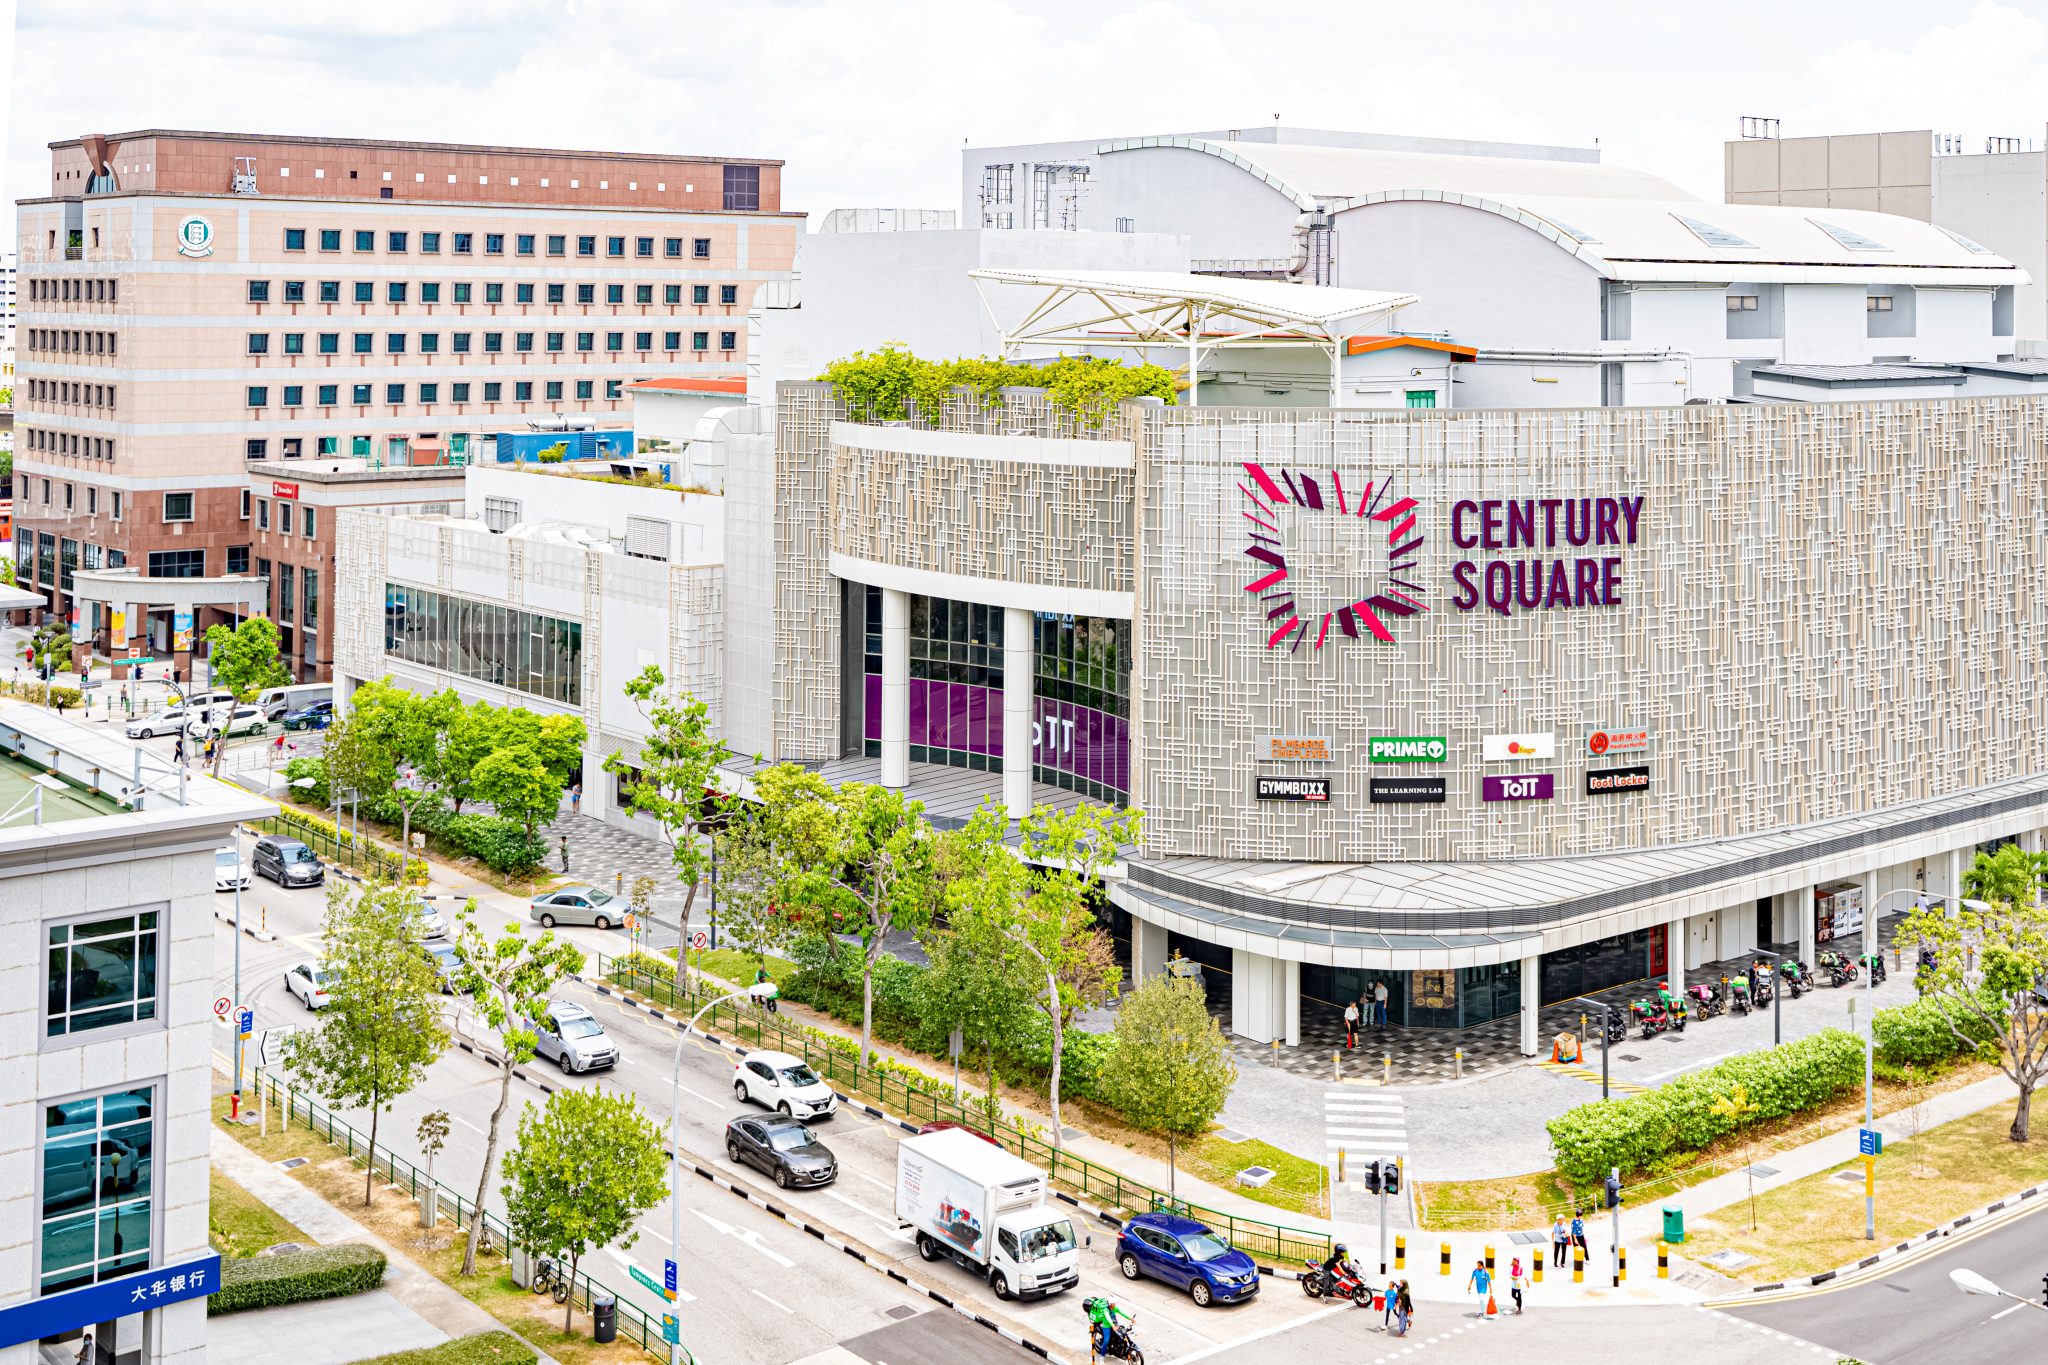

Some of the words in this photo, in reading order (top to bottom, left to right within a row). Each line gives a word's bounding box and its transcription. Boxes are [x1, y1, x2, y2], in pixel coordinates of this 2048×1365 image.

[1452, 497, 1644, 549] CENTURY
[1452, 557, 1622, 616] SQUARE
[1271, 739, 1325, 750] FILMGARDE
[1372, 741, 1427, 757] PRIME
[1271, 749, 1329, 760] CINEPLEXES
[1259, 780, 1325, 796] GYMMBOXX
[1500, 778, 1539, 798] ToTT
[1590, 777, 1613, 789] Foot
[1614, 774, 1648, 787] Locker
[131, 1270, 205, 1303] 大华银行
